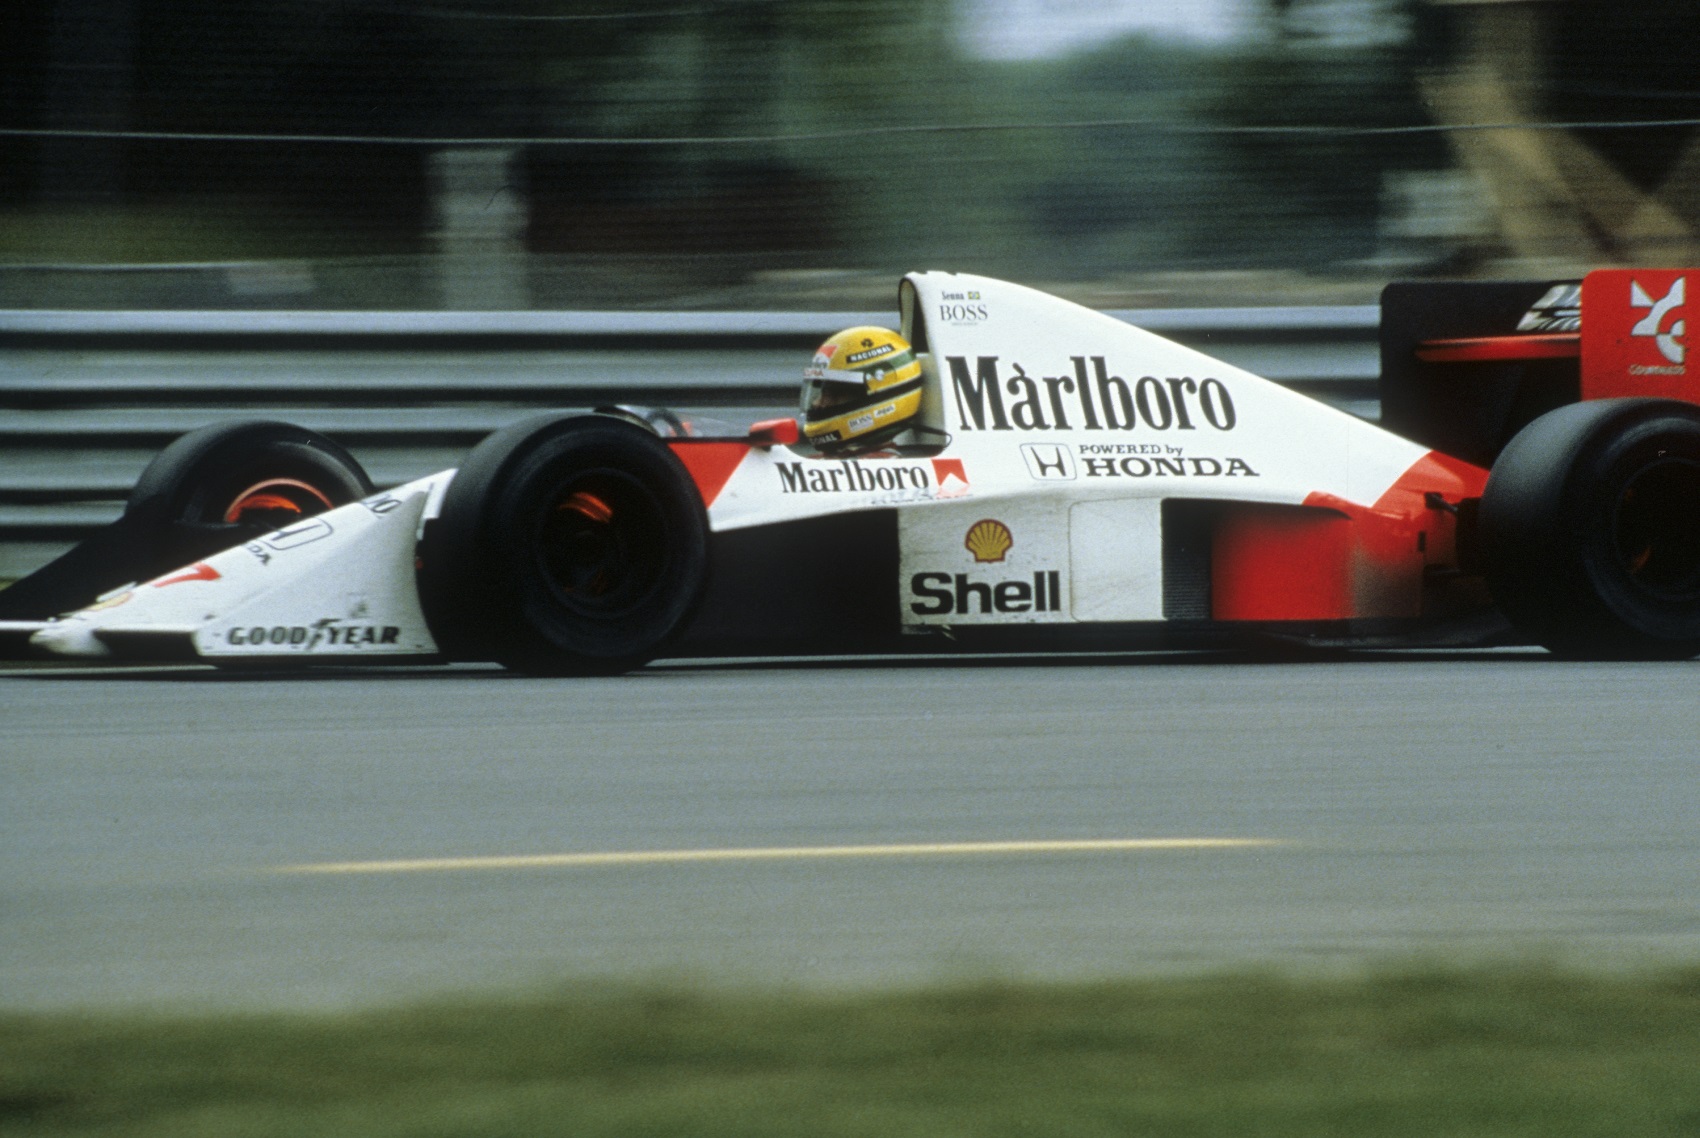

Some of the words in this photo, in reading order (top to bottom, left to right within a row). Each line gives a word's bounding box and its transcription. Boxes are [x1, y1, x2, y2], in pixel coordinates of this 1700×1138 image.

[940, 304, 988, 321] BOSS
[850, 346, 892, 360] NACIONAL
[1079, 444, 1161, 455] POWERED
[1165, 444, 1183, 458] by
[774, 459, 929, 493] Marlboro
[1081, 456, 1260, 477] HONDA
[910, 570, 1061, 615] Shell
